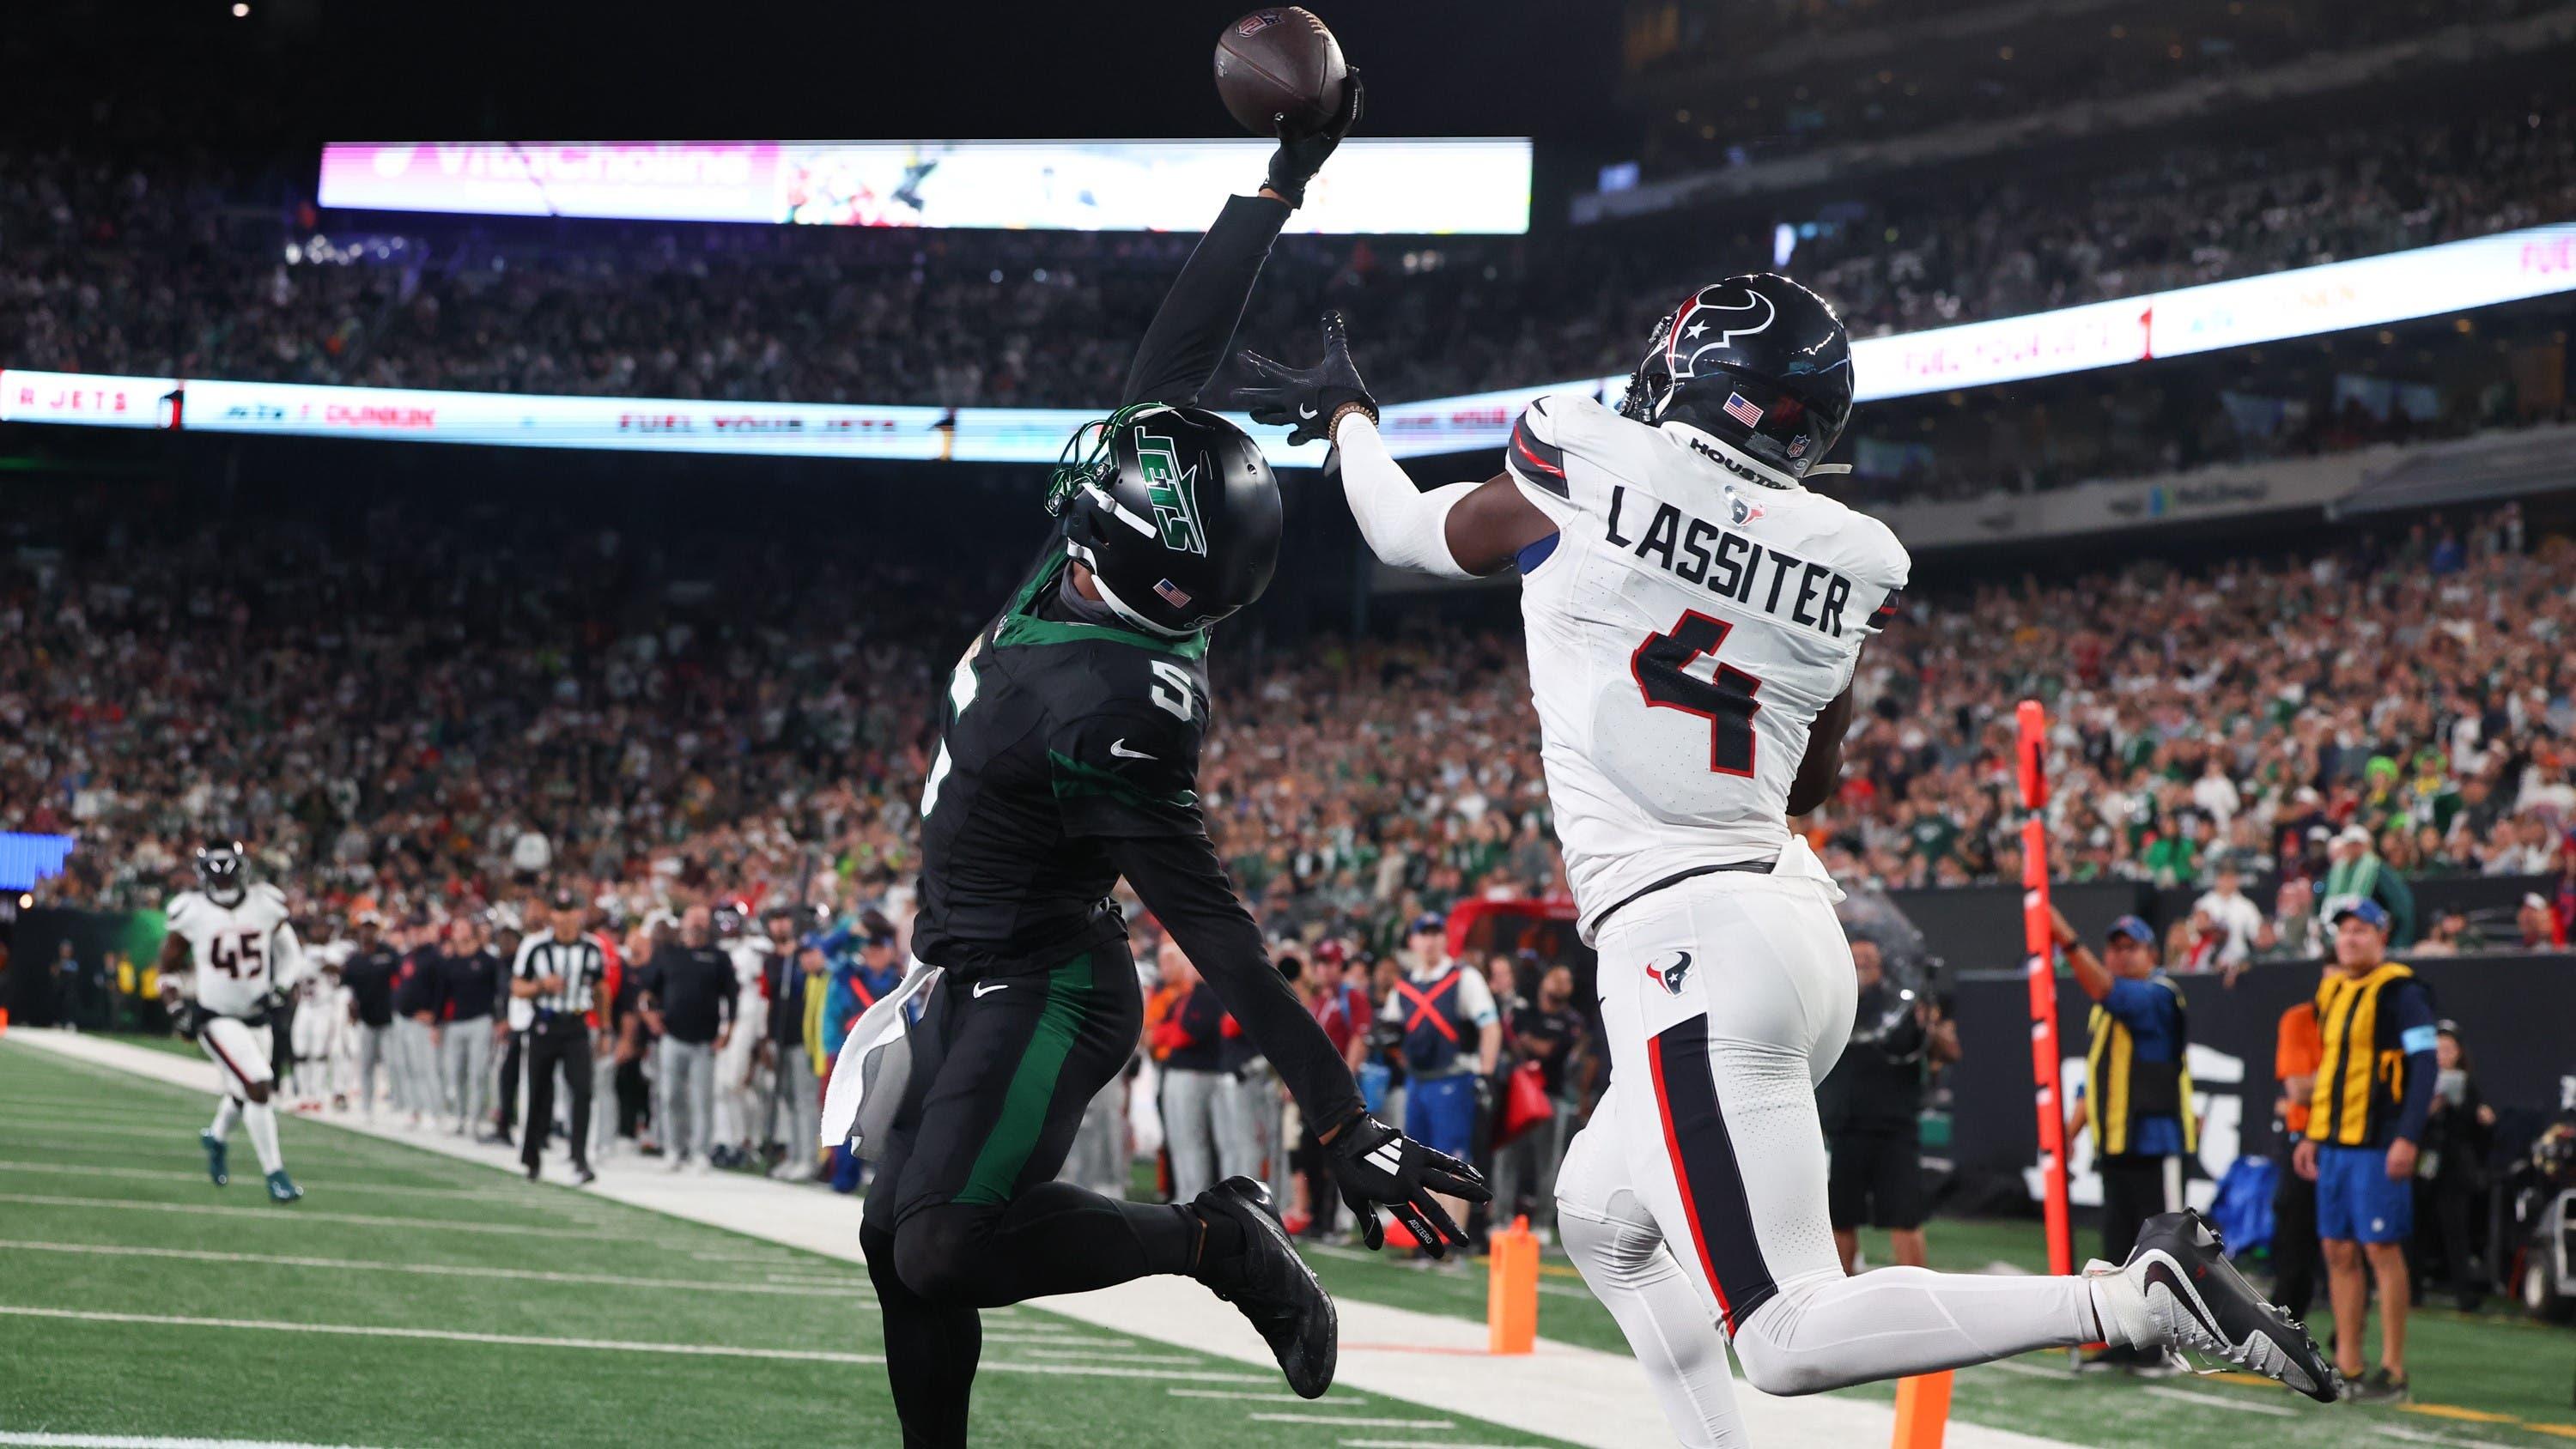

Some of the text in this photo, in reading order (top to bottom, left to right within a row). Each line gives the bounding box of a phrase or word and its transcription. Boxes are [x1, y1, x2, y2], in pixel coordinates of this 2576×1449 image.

[1134, 426, 1204, 555] JETS
[1605, 486, 1852, 638] LASSITER
[1149, 658, 1194, 723] 5
[1631, 608, 1762, 779] 4
[210, 931, 264, 980] 45
[1407, 1219, 1433, 1245] ADIZERO
